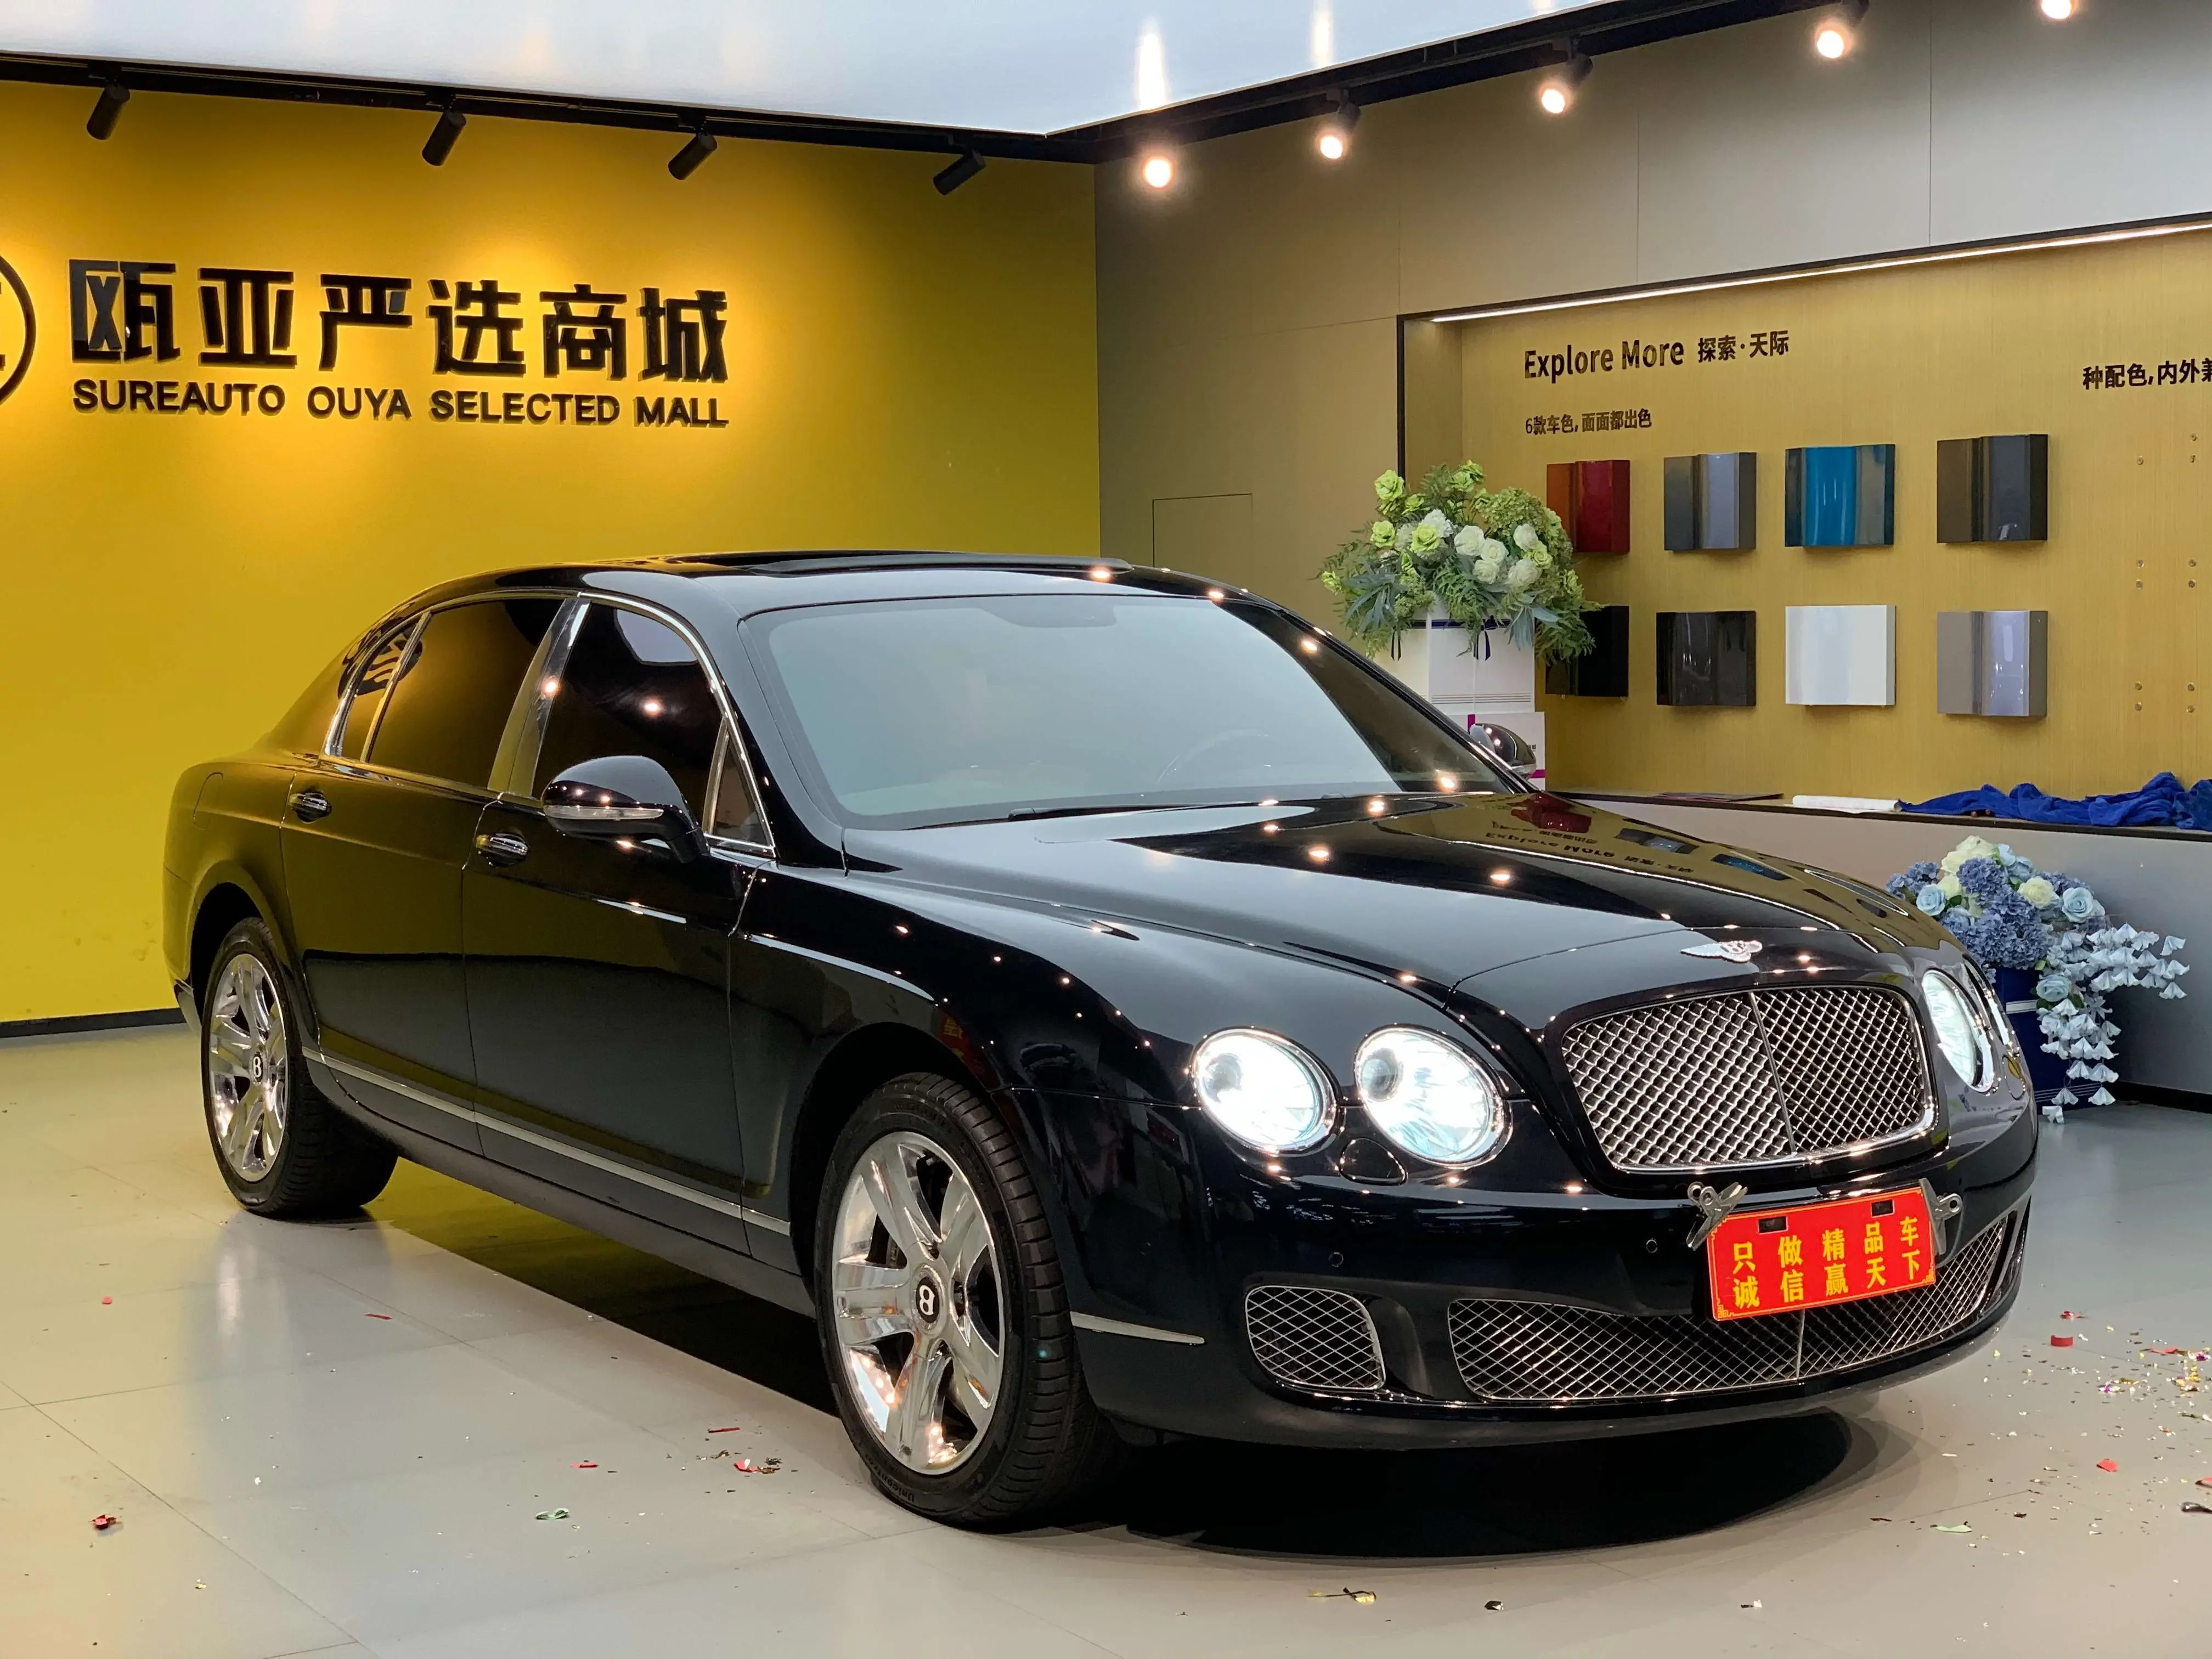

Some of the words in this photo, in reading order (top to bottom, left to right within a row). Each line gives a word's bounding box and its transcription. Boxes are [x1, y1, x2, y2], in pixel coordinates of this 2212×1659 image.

[68, 258, 729, 383] 瓯亚严选商城
[1525, 345, 1613, 384] Explore
[1621, 340, 1684, 370] More
[72, 378, 286, 415] SUREAUTO
[307, 386, 411, 419] OUYA
[431, 389, 620, 424] SELECTED
[636, 396, 729, 425] MALL
[1732, 1216, 1920, 1274] 只做精品车
[1733, 1249, 1921, 1310] 诚信赢天下
